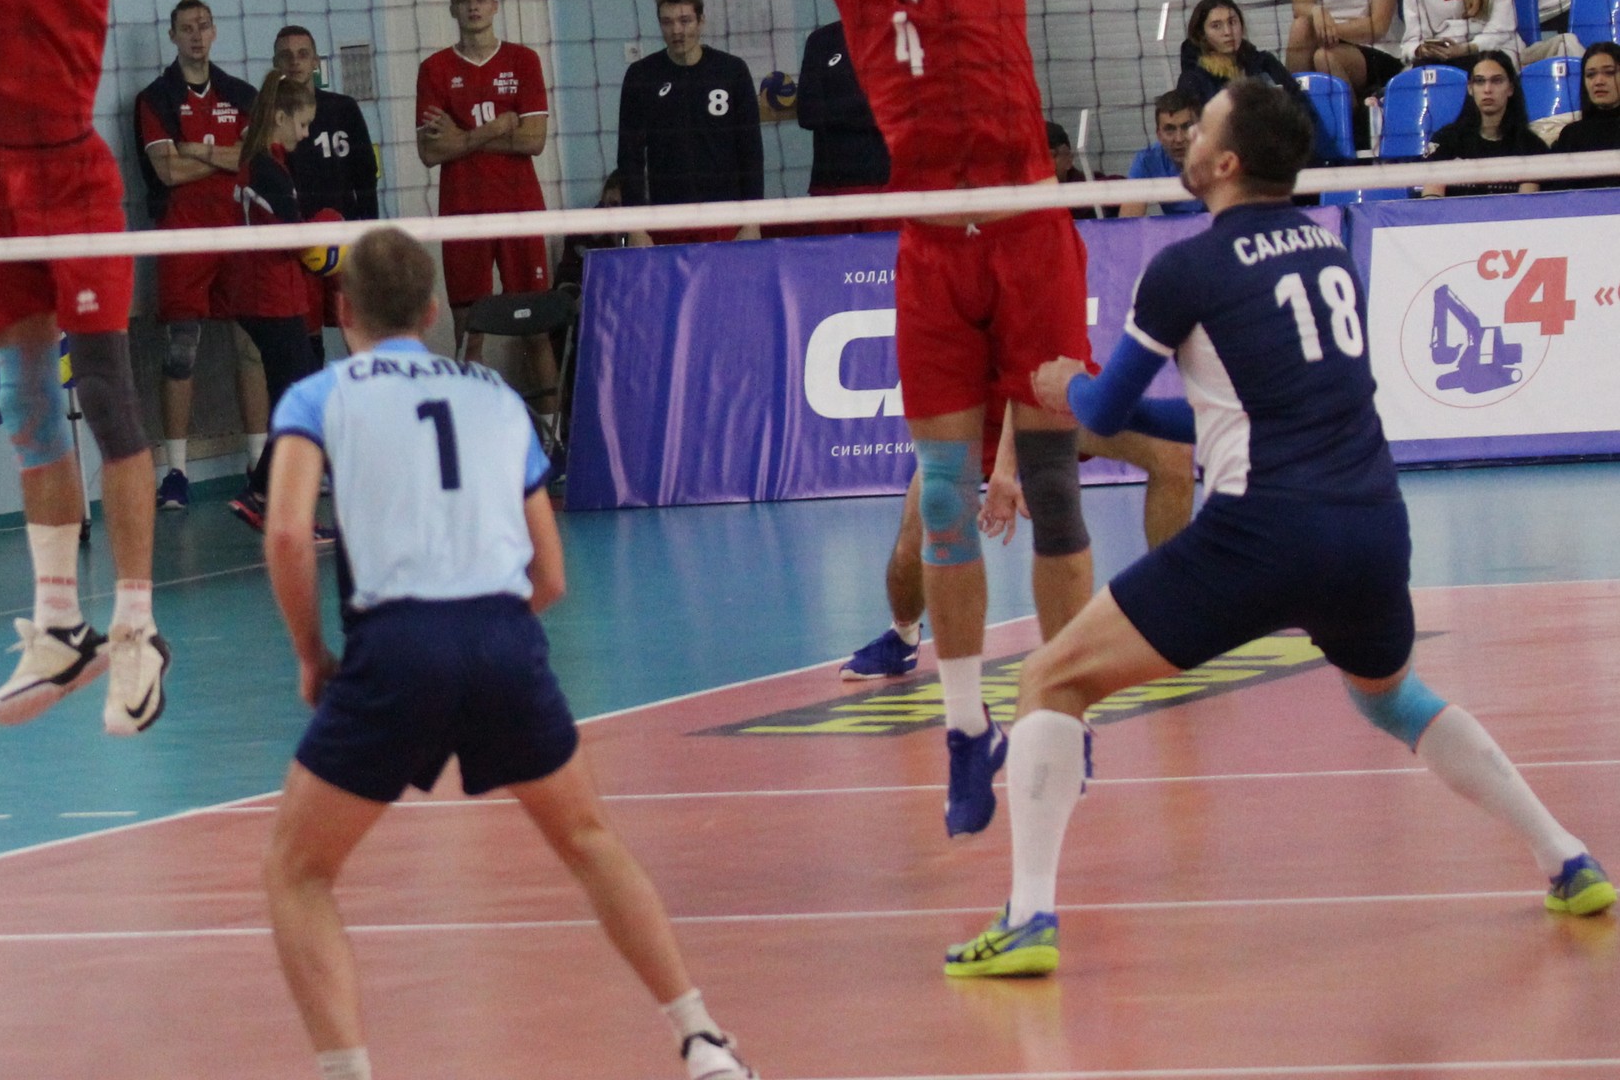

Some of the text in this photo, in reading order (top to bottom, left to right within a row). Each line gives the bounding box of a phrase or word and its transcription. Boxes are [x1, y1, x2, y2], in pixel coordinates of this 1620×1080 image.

[708, 89, 729, 116] 8
[314, 130, 350, 158] 16
[844, 270, 897, 284] ХОЛДИ
[1477, 249, 1528, 281] СУ
[1504, 256, 1577, 336] 4
[1274, 265, 1364, 363] 18
[416, 398, 461, 490] 1
[831, 442, 915, 457] СИБИРСКИ
